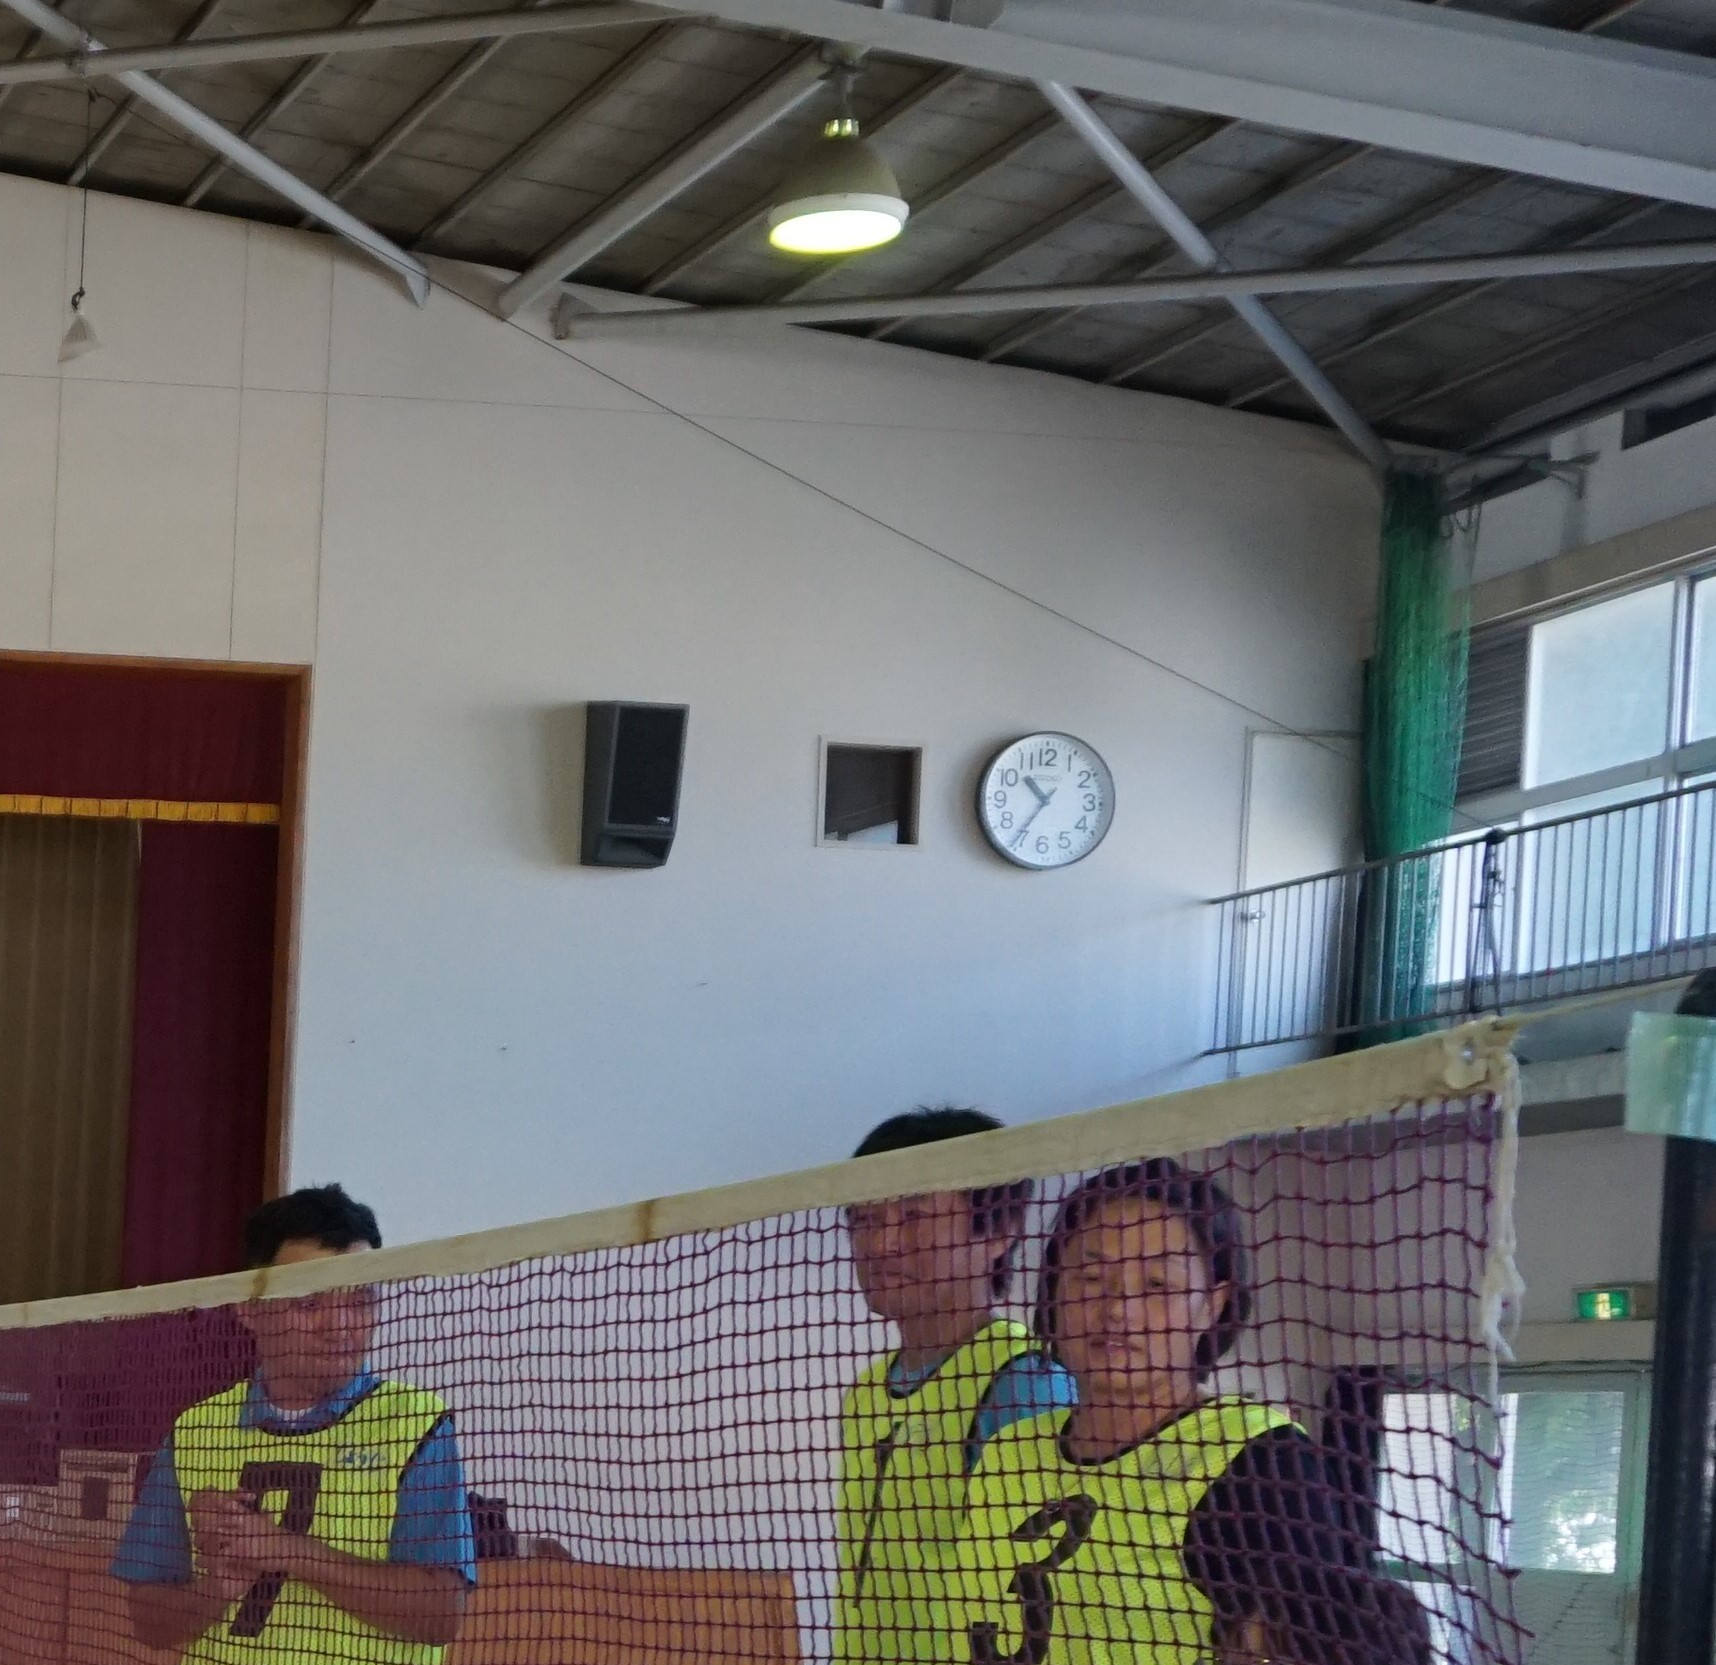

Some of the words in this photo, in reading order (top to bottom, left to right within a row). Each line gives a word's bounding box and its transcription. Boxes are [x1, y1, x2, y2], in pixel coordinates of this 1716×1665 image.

[1020, 752, 1034, 770] 11
[1039, 748, 1057, 766] 12
[1000, 768, 1018, 787] 10
[1078, 770, 1090, 788] 2
[994, 790, 1007, 808] 9
[1082, 793, 1096, 812] 3
[1000, 812, 1013, 829] 8
[1075, 816, 1088, 832] 4
[1018, 830, 1029, 847] 7
[1036, 836, 1049, 854] 6
[1058, 831, 1071, 849] 5
